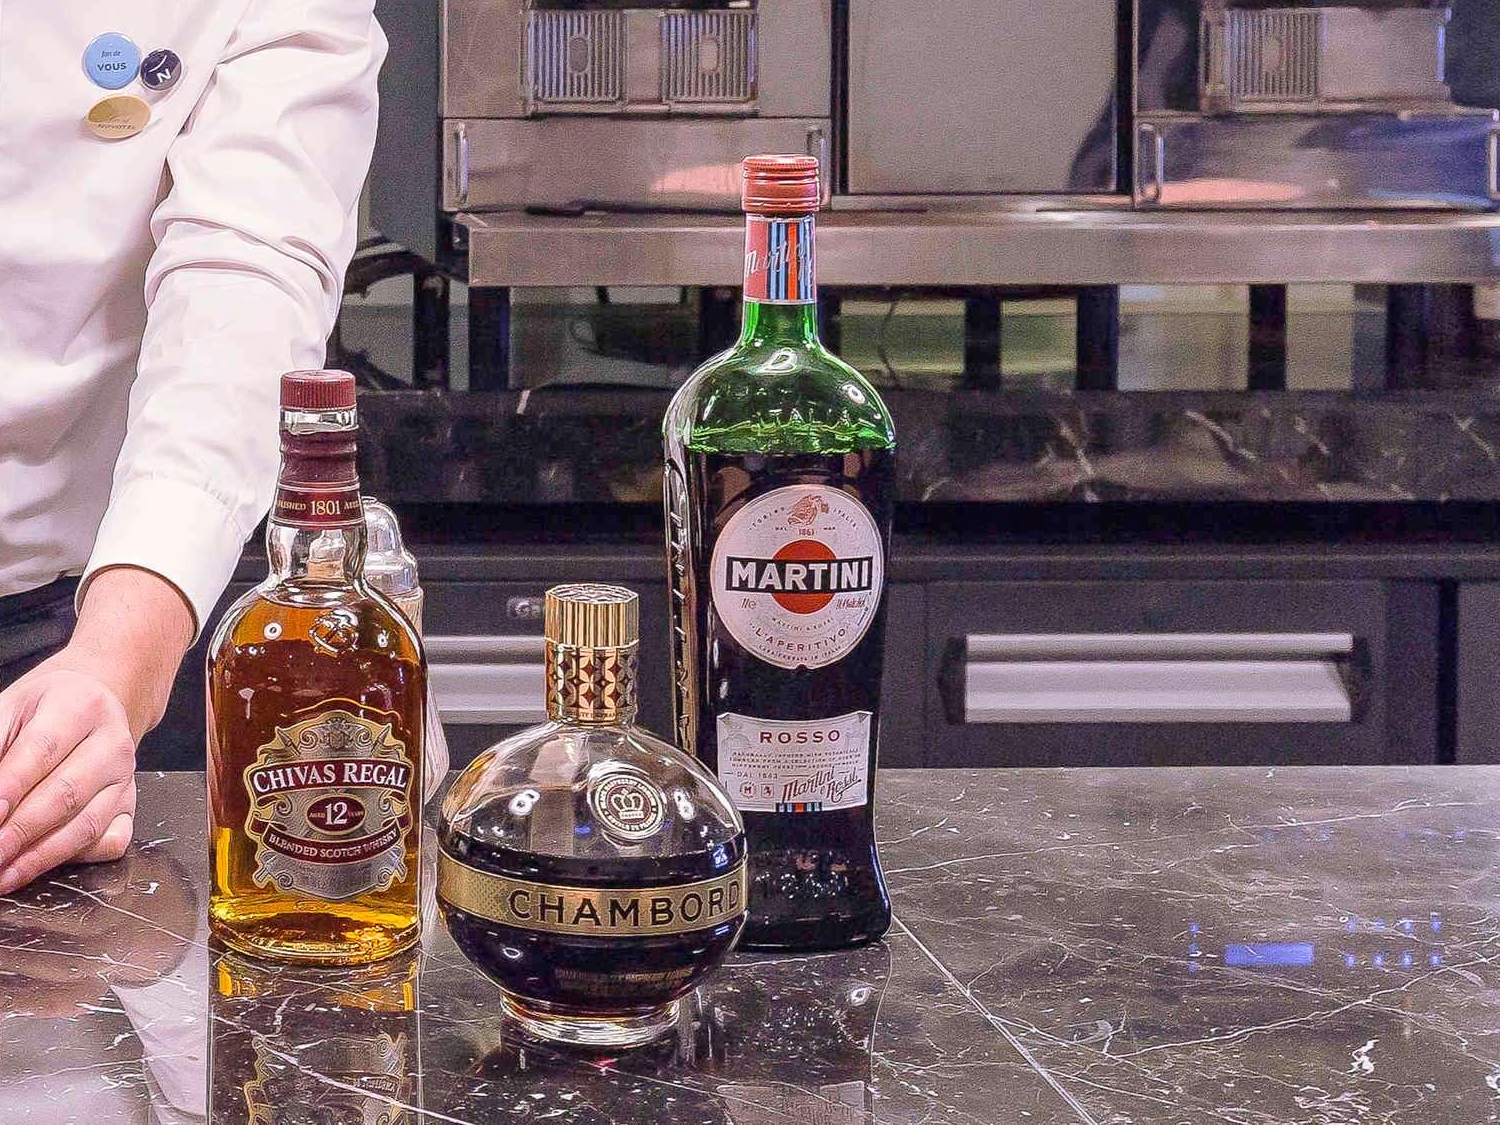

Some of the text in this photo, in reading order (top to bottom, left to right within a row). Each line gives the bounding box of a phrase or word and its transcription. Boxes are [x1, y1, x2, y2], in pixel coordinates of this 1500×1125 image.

[311, 500, 341, 516] 1801
[731, 559, 869, 590] MARTINI
[759, 729, 841, 744] ROSSO
[253, 761, 408, 793] CHIVAS REGAL
[781, 766, 835, 803] Martini
[324, 801, 348, 826] 12
[268, 833, 319, 857] BLENDED
[320, 846, 362, 859] SCOTCH
[506, 878, 741, 928] CHAMBORD
